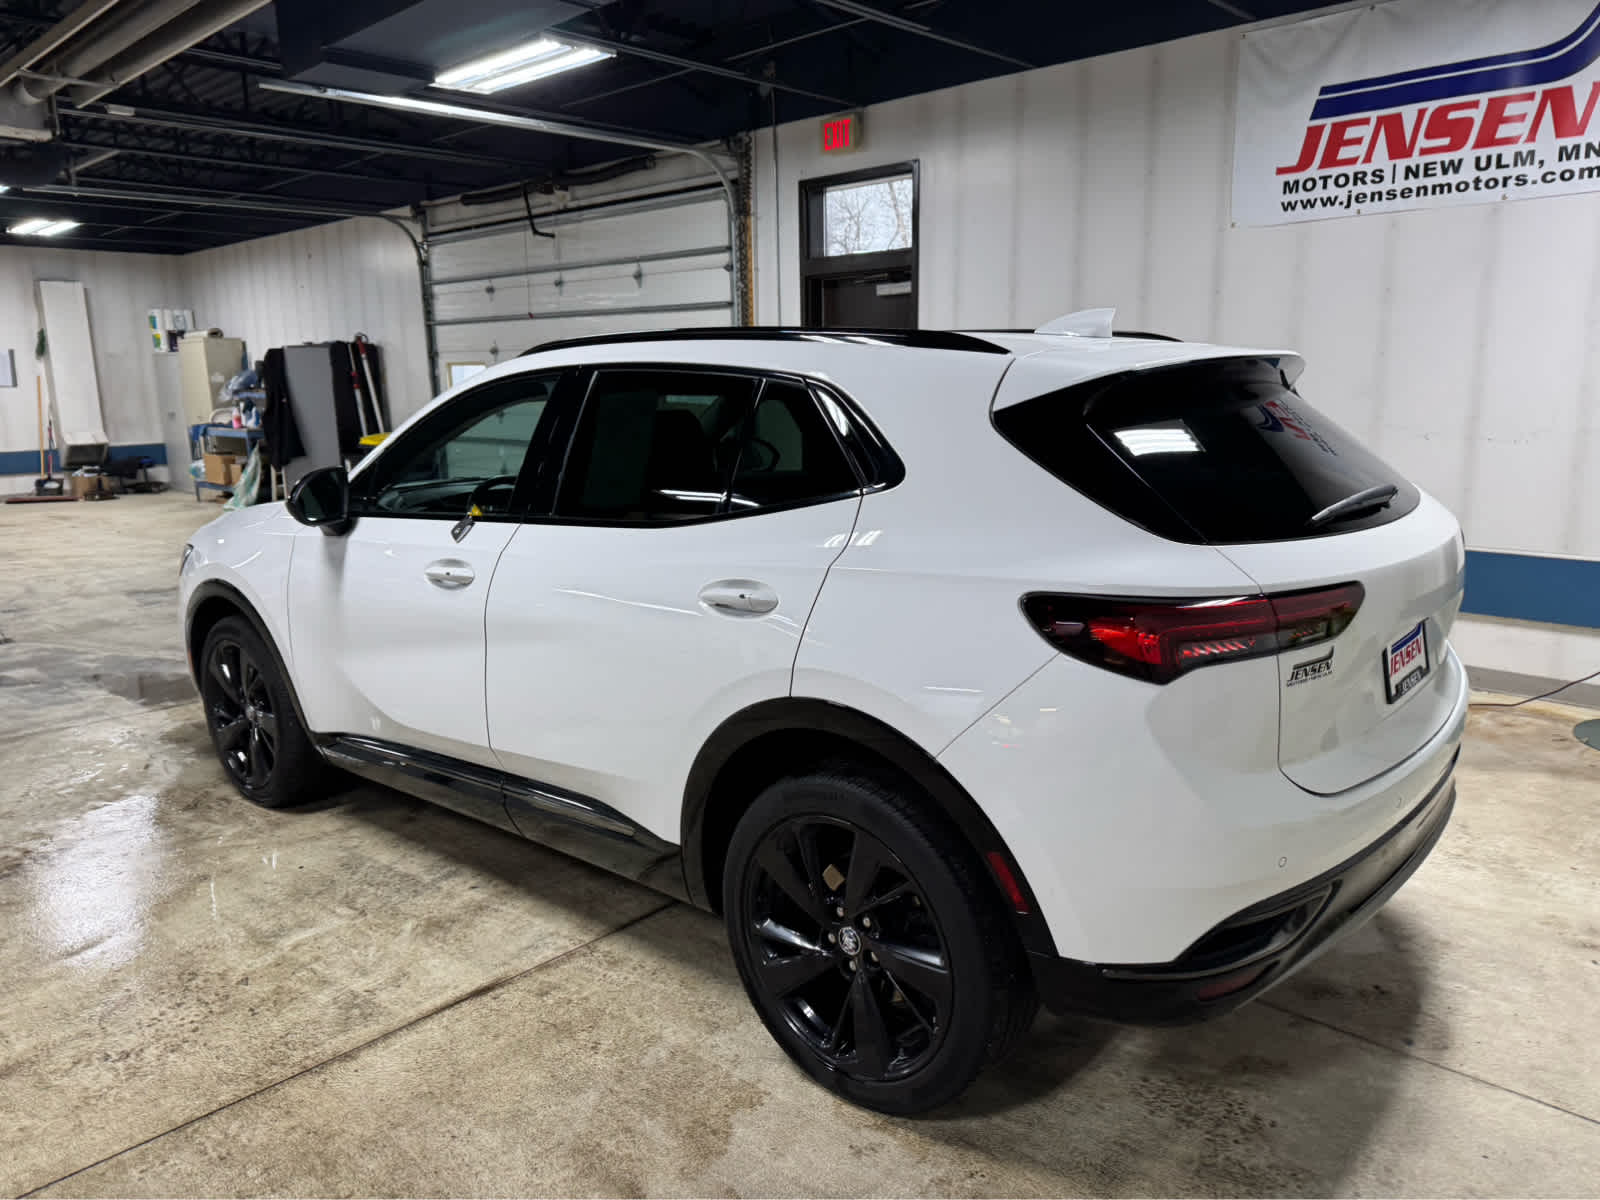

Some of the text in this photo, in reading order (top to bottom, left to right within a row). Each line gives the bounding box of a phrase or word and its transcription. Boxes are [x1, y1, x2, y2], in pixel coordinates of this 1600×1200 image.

[824, 119, 851, 151] EXIT
[1276, 81, 1600, 176] JENSEN
[1281, 165, 1600, 212] www.jensenmotors.com
[1282, 168, 1385, 195] MOTORS
[1404, 158, 1464, 181] NEW
[1474, 149, 1544, 172] ULM,
[1288, 660, 1333, 681] JENSEN
[1390, 636, 1423, 677] JENSEN
